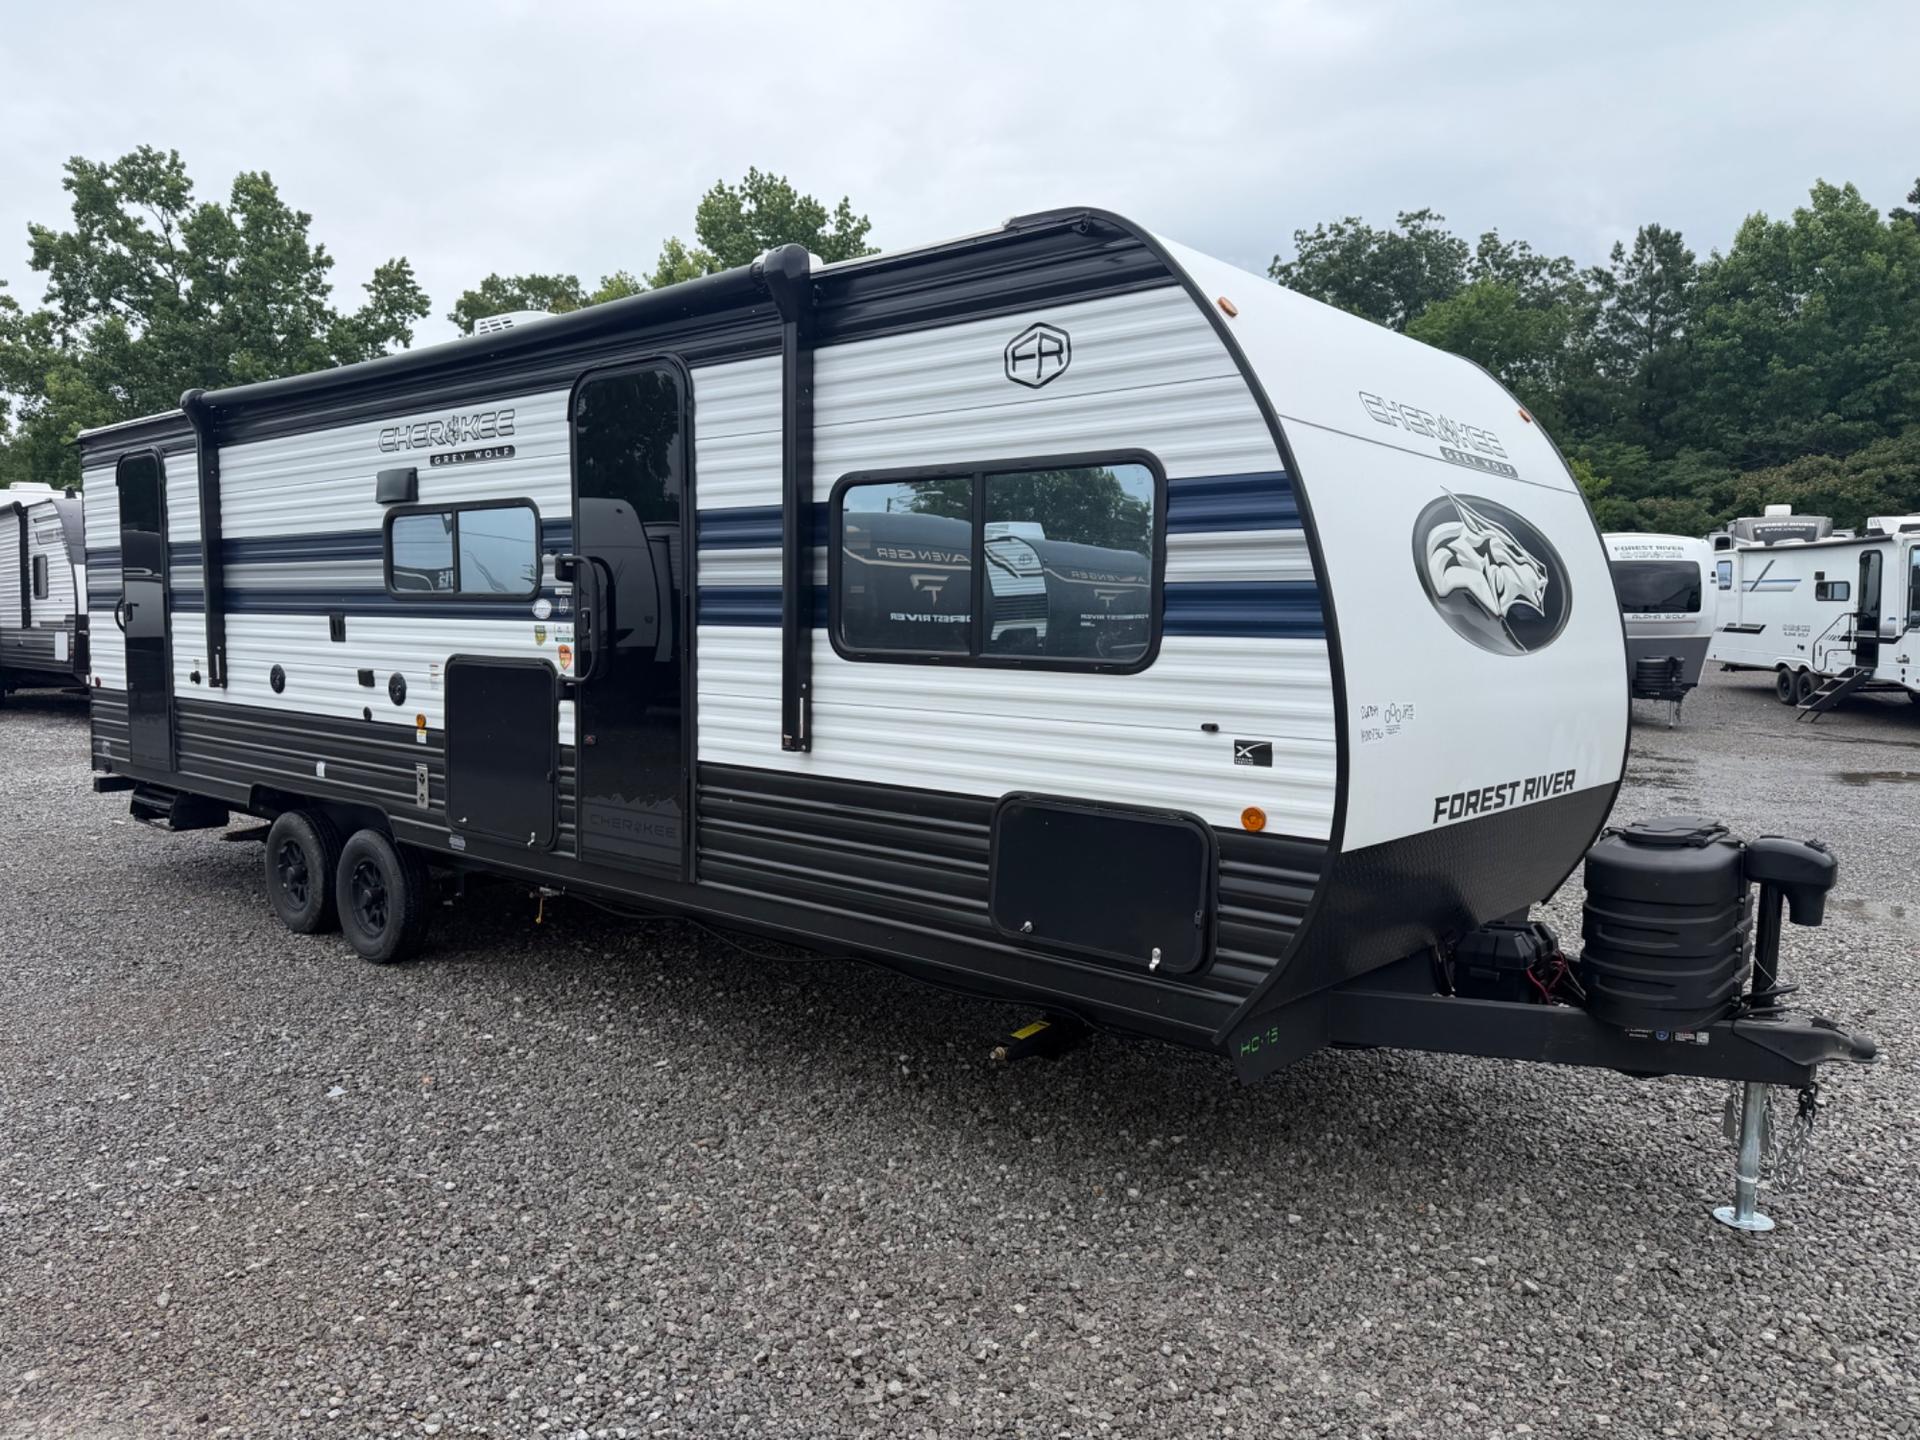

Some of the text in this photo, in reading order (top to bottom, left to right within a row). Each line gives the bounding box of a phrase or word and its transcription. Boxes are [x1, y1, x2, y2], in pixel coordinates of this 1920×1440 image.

[378, 408, 515, 452] CHEROKEE
[434, 447, 510, 465] GREY WOLF
[1432, 769, 1576, 825] FOREST RIVER
